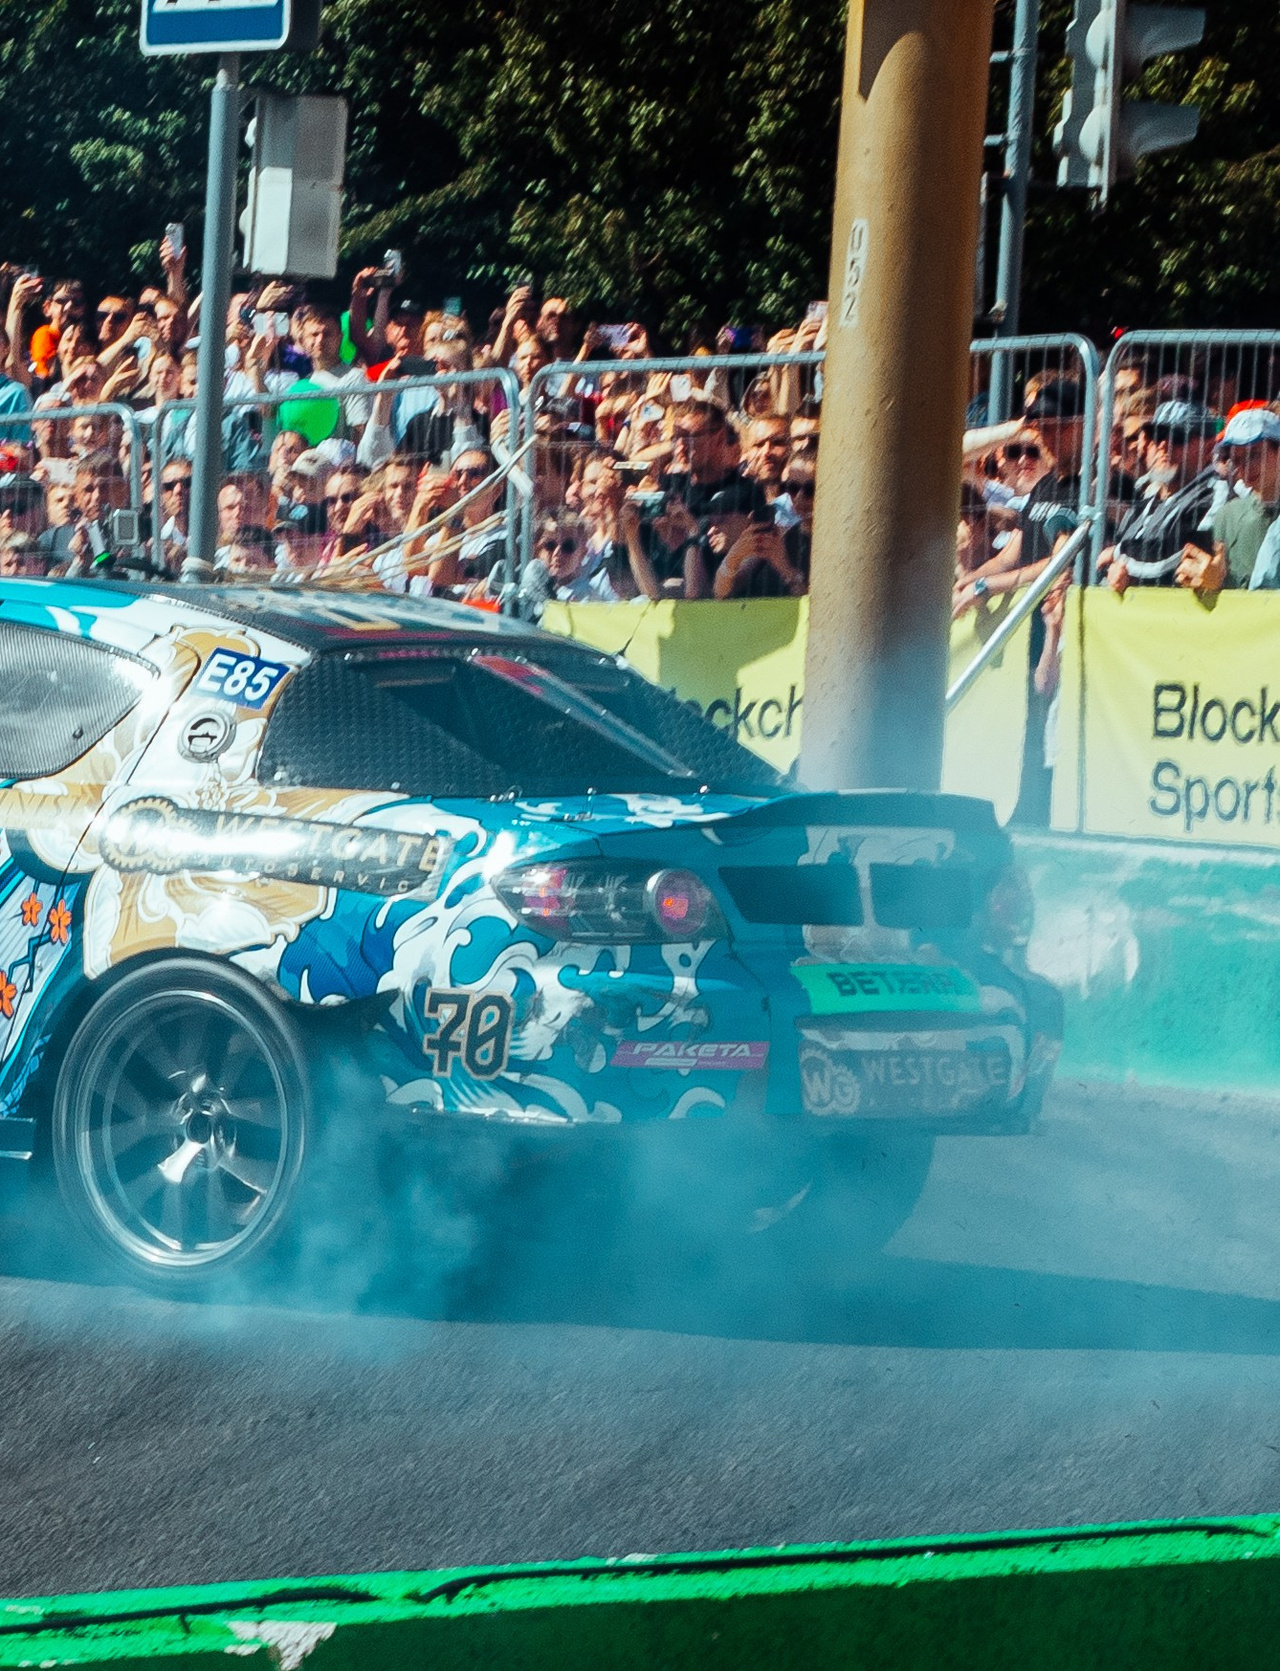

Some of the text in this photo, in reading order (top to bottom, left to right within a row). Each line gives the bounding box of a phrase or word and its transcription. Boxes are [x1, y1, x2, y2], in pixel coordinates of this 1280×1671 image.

[197, 653, 279, 702] E85
[1150, 760, 1280, 831] Sport
[215, 813, 441, 874] WTGATE
[198, 852, 436, 899] AUTOSERVIC
[422, 987, 517, 1080] 70
